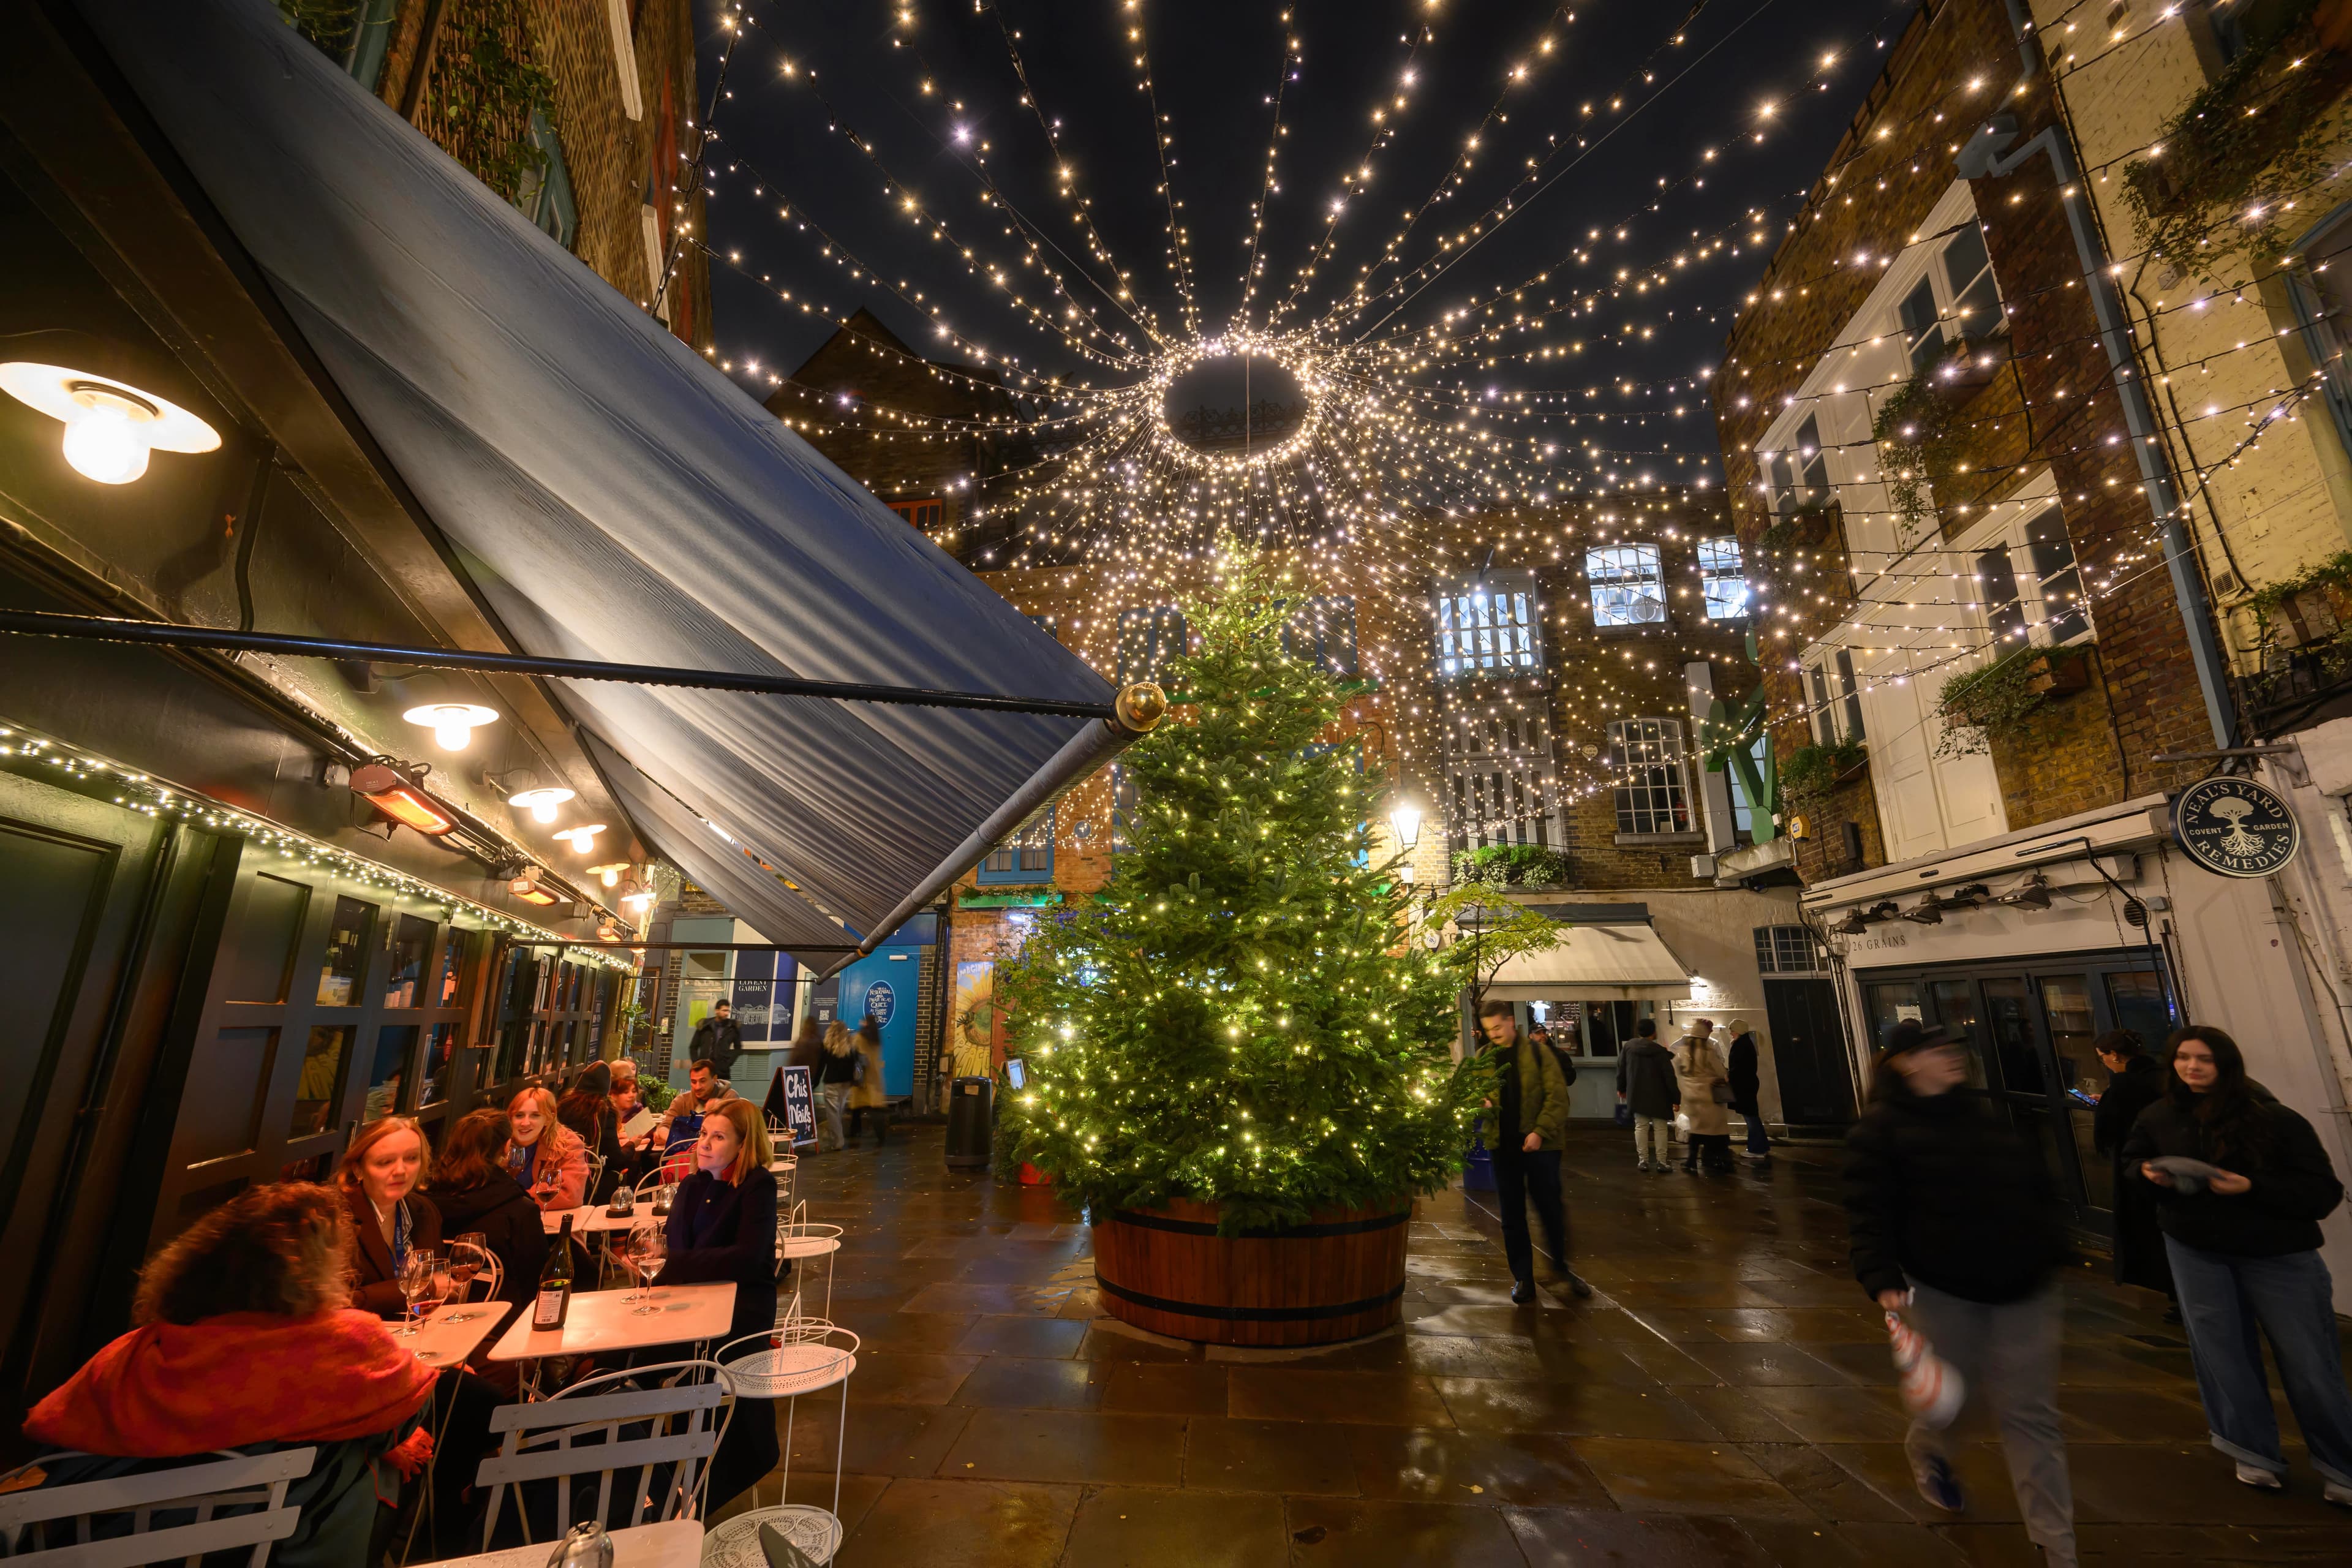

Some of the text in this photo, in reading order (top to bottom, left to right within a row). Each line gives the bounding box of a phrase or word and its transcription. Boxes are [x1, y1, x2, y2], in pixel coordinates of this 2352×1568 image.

[2186, 783, 2283, 824] NEAL'S YARD
[2253, 823, 2290, 831] GARDEN
[2196, 834, 2290, 869] REMEDIES
[1852, 935, 1905, 951] 26 GRAINS
[957, 962, 992, 979] IMAGINE
[786, 1073, 808, 1098] Chi's
[789, 1103, 812, 1125] Nails
